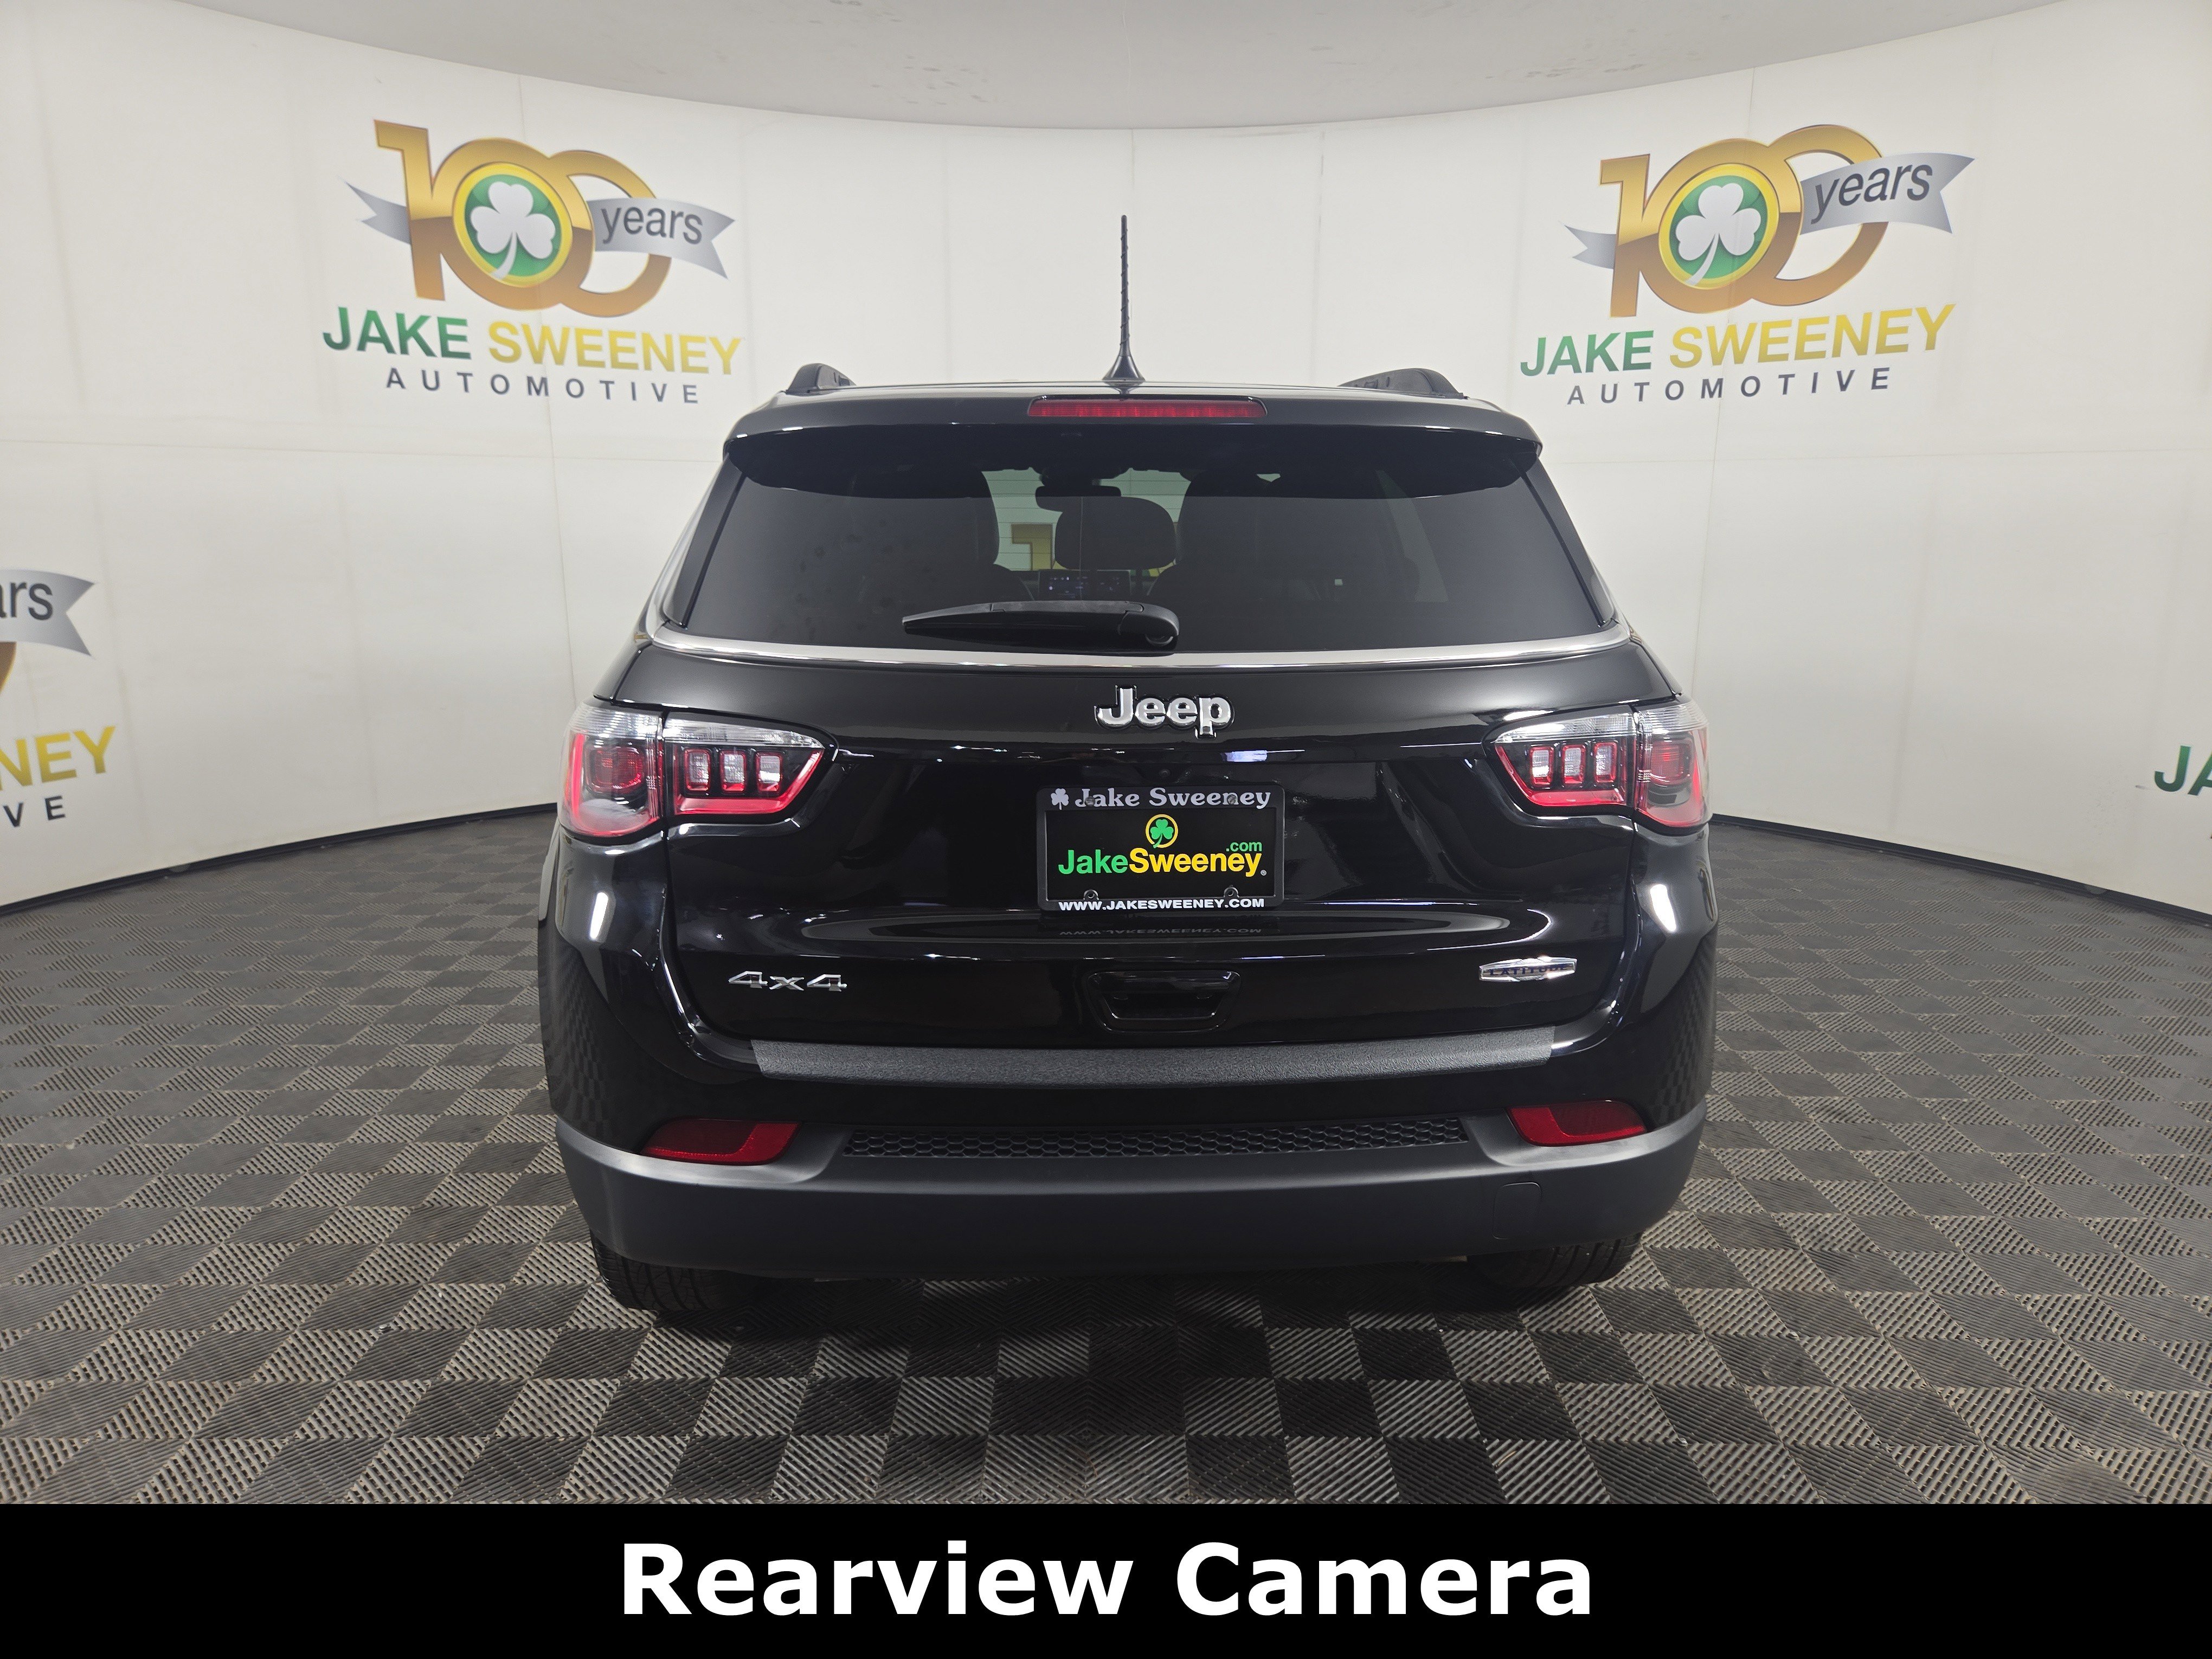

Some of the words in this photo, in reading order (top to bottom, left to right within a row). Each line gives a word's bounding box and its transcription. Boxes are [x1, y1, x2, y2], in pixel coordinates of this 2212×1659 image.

[374, 120, 672, 318] 100
[600, 206, 703, 244] years
[1599, 124, 1890, 319] 100
[1810, 164, 1933, 224] years
[323, 306, 472, 360] JAKE
[488, 320, 742, 375] SWEENEY
[1520, 330, 1654, 377] JAKE
[1669, 304, 1956, 369] SWEENEY
[385, 367, 699, 404] AUTOMOTIVE
[1566, 367, 1890, 405] AUTOMOTIVE
[0, 582, 54, 621] rs
[1097, 687, 1232, 736] Jeep
[1075, 788, 1140, 807] Jake
[1149, 787, 1271, 809] Sweeney
[1226, 841, 1262, 852] .com
[1058, 898, 1265, 911] WWW.JAKESWEENEY.COM
[728, 971, 847, 992] 4x4
